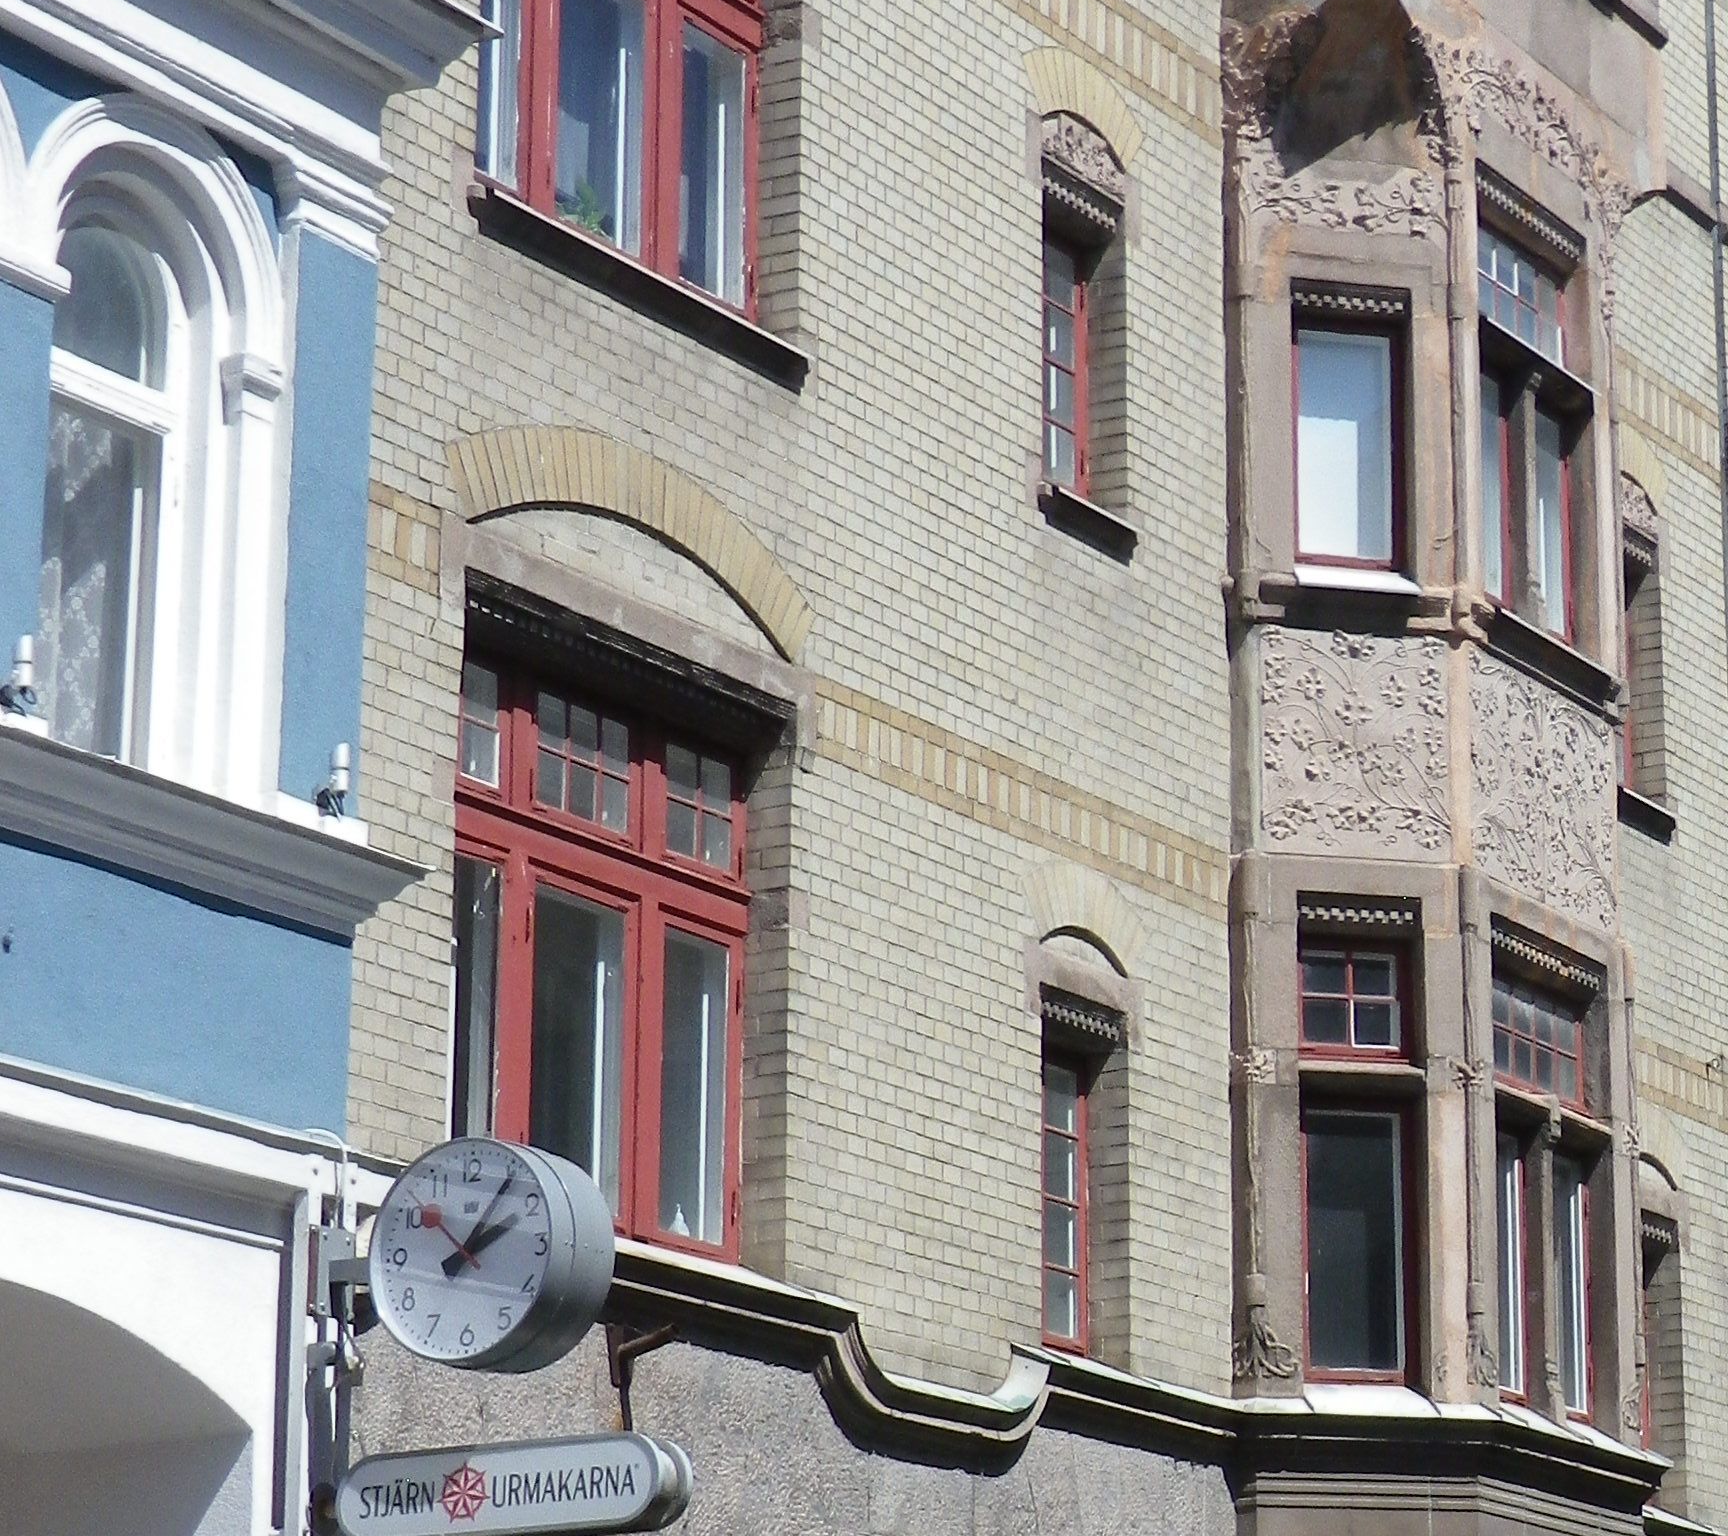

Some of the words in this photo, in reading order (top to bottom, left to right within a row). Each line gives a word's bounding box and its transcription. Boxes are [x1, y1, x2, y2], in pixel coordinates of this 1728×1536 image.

[463, 1158, 483, 1183] 12
[432, 1175, 448, 1199] 11
[525, 1192, 540, 1217] 2
[405, 1205, 424, 1230] 10
[534, 1232, 548, 1257] 3
[521, 1273, 536, 1299] 4
[402, 1287, 416, 1312] 8
[426, 1313, 441, 1339] 7
[497, 1306, 512, 1331] 5
[459, 1323, 475, 1347] 6
[359, 1477, 436, 1519] STJÄRN
[491, 1465, 636, 1509] URMAKARNA
